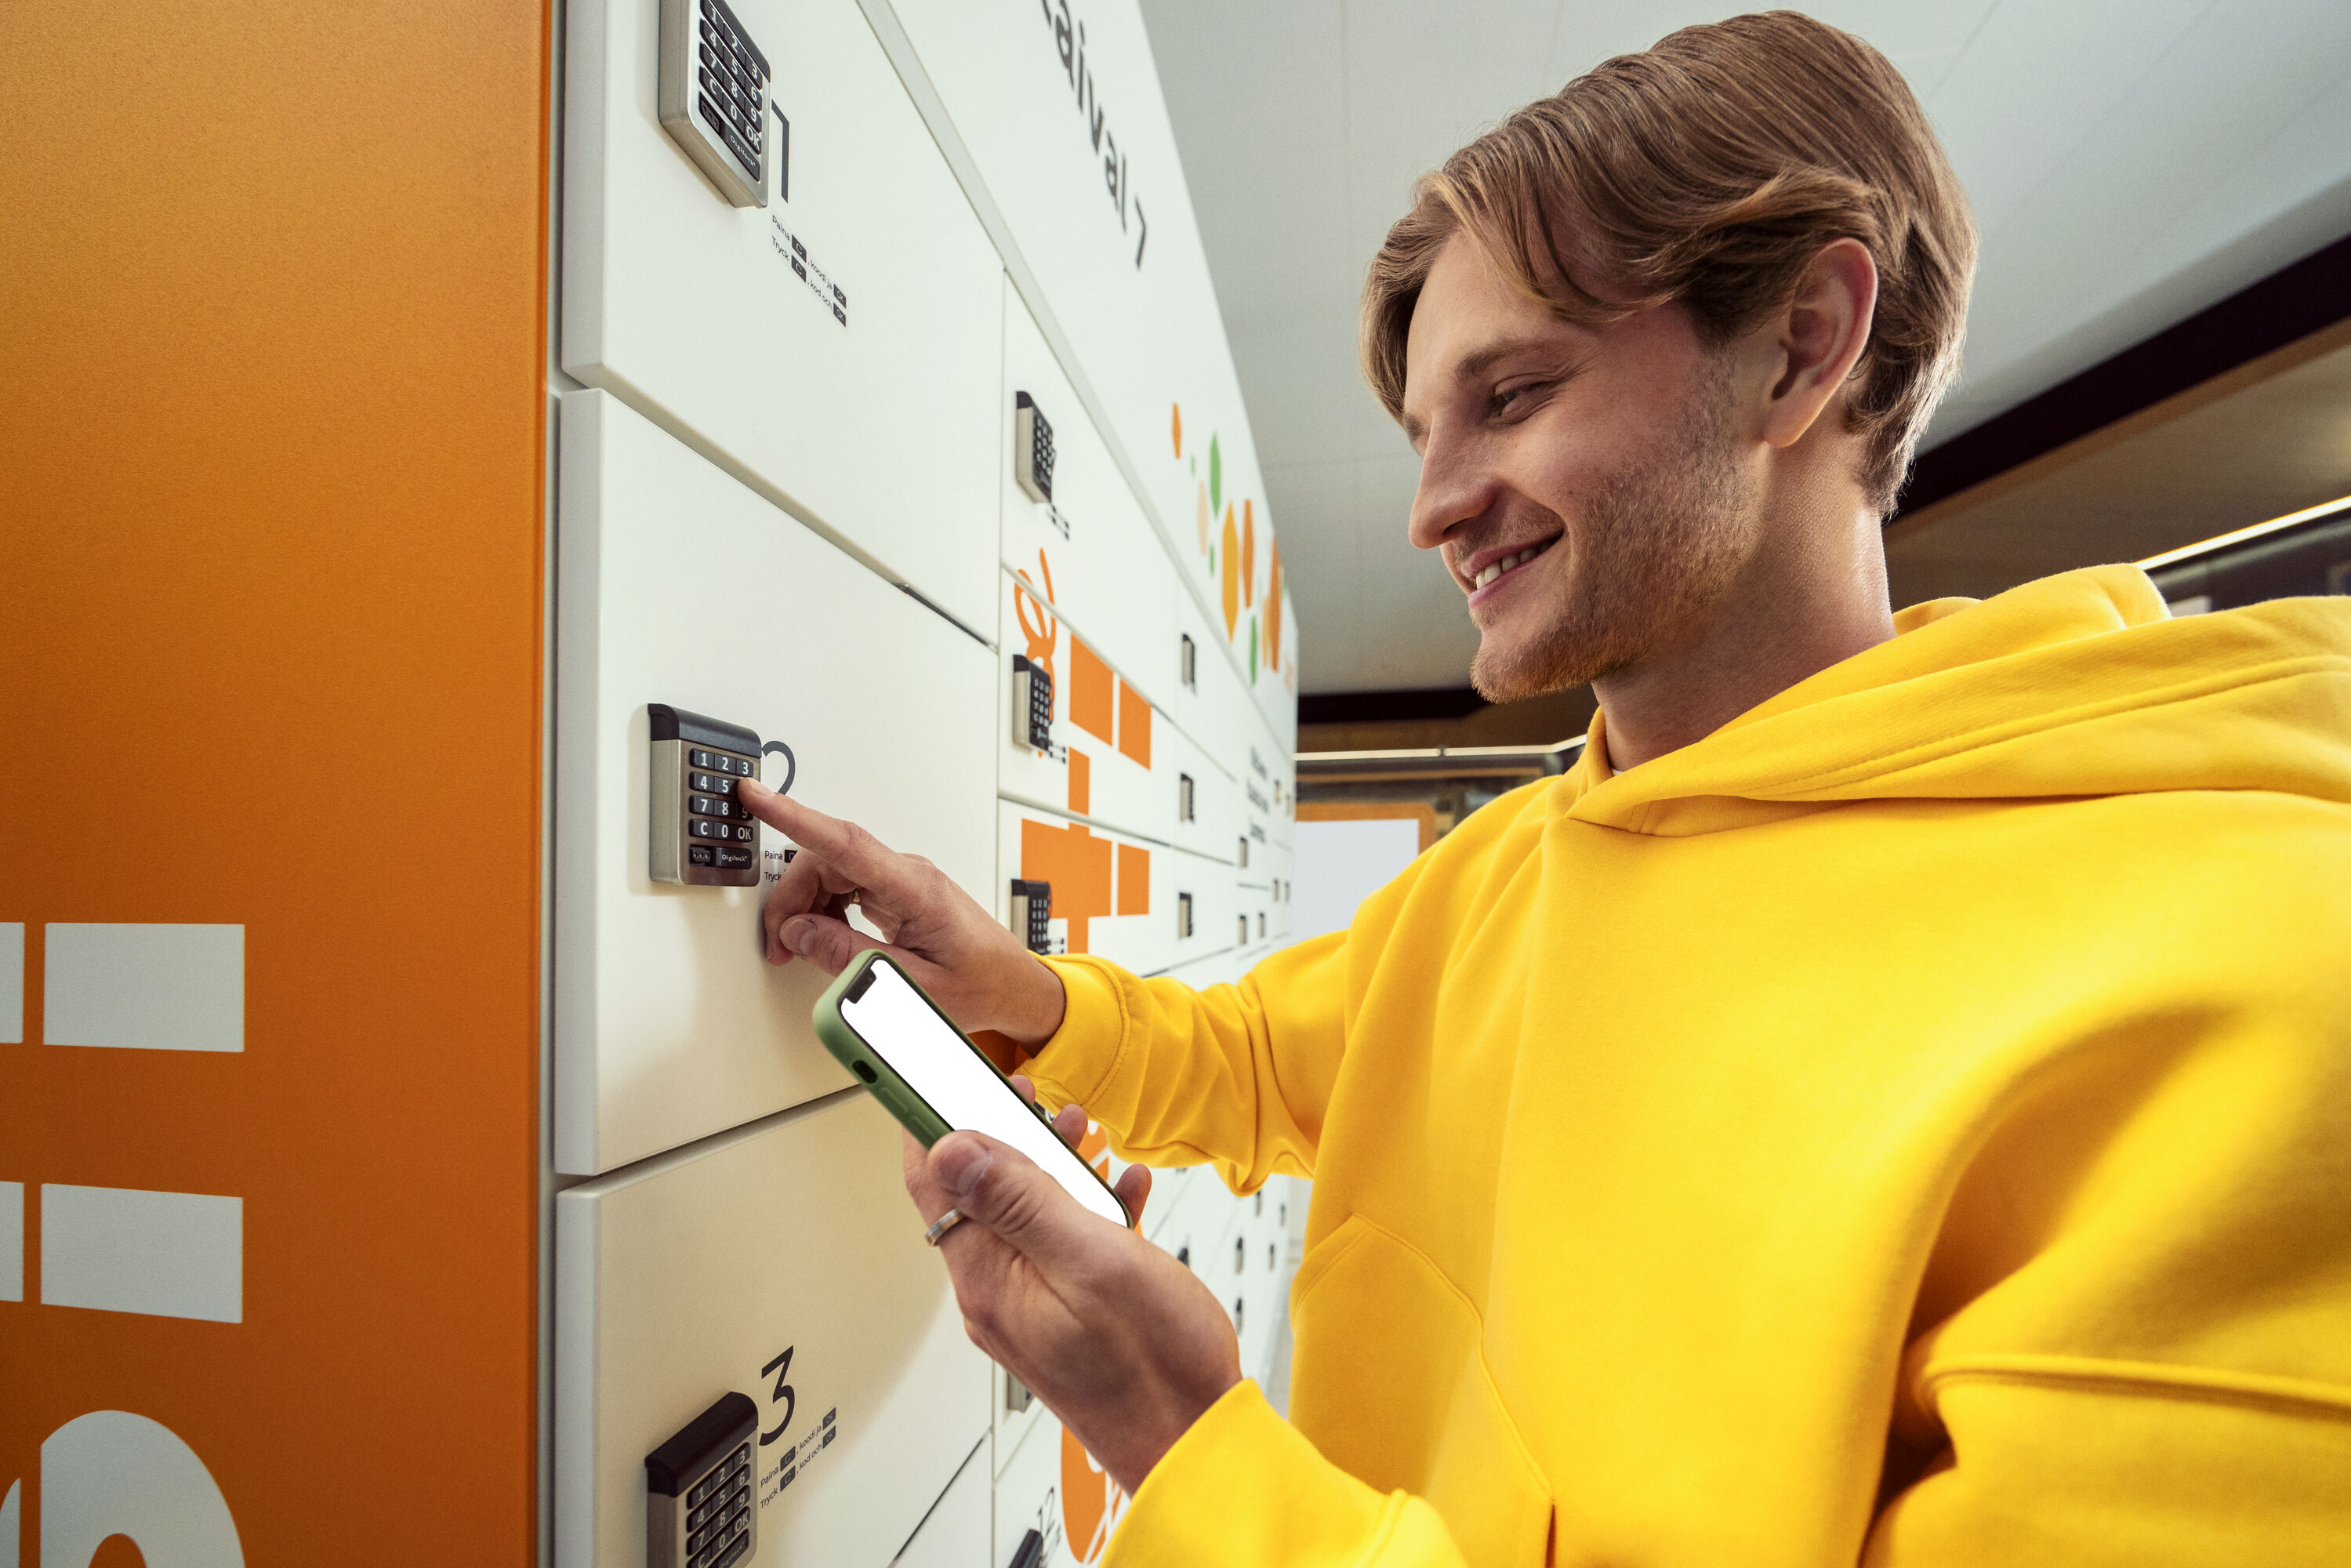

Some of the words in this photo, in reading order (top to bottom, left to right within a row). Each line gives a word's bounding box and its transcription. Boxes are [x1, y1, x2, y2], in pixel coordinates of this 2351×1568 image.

[710, 7, 717, 26] 1
[731, 34, 738, 53] 2
[751, 59, 758, 79] 3
[709, 31, 717, 49] 4
[731, 58, 738, 76] 5
[751, 82, 757, 102] 6
[709, 53, 717, 69] 7
[731, 81, 738, 99] 8
[751, 103, 757, 122] 9
[709, 78, 717, 96] C
[746, 123, 760, 151] OK
[1041, 0, 1127, 234] aival
[772, 215, 790, 241] Paina
[771, 235, 789, 262] Tryck
[701, 753, 708, 767] 1
[722, 757, 729, 771] 2
[742, 761, 749, 775] 3
[700, 776, 708, 789] 4
[722, 779, 729, 793] 5
[701, 799, 708, 812] 7
[722, 802, 729, 815] 8
[701, 822, 708, 836] C
[738, 827, 751, 840] OK
[764, 850, 783, 860] Paina
[764, 872, 782, 882] Tryck
[759, 1345, 796, 1446] 3
[697, 1487, 705, 1502] 1
[718, 1467, 726, 1483] 2
[739, 1450, 746, 1464] 3
[760, 1466, 779, 1488] Paina
[697, 1509, 705, 1523] 4
[719, 1491, 726, 1506] 5
[738, 1472, 746, 1486] 6
[760, 1487, 778, 1508] Tryck
[697, 1553, 706, 1568] C
[735, 1510, 749, 1533] OK
[698, 1532, 706, 1547] 7
[719, 1513, 726, 1527] 8
[738, 1493, 745, 1508] 9
